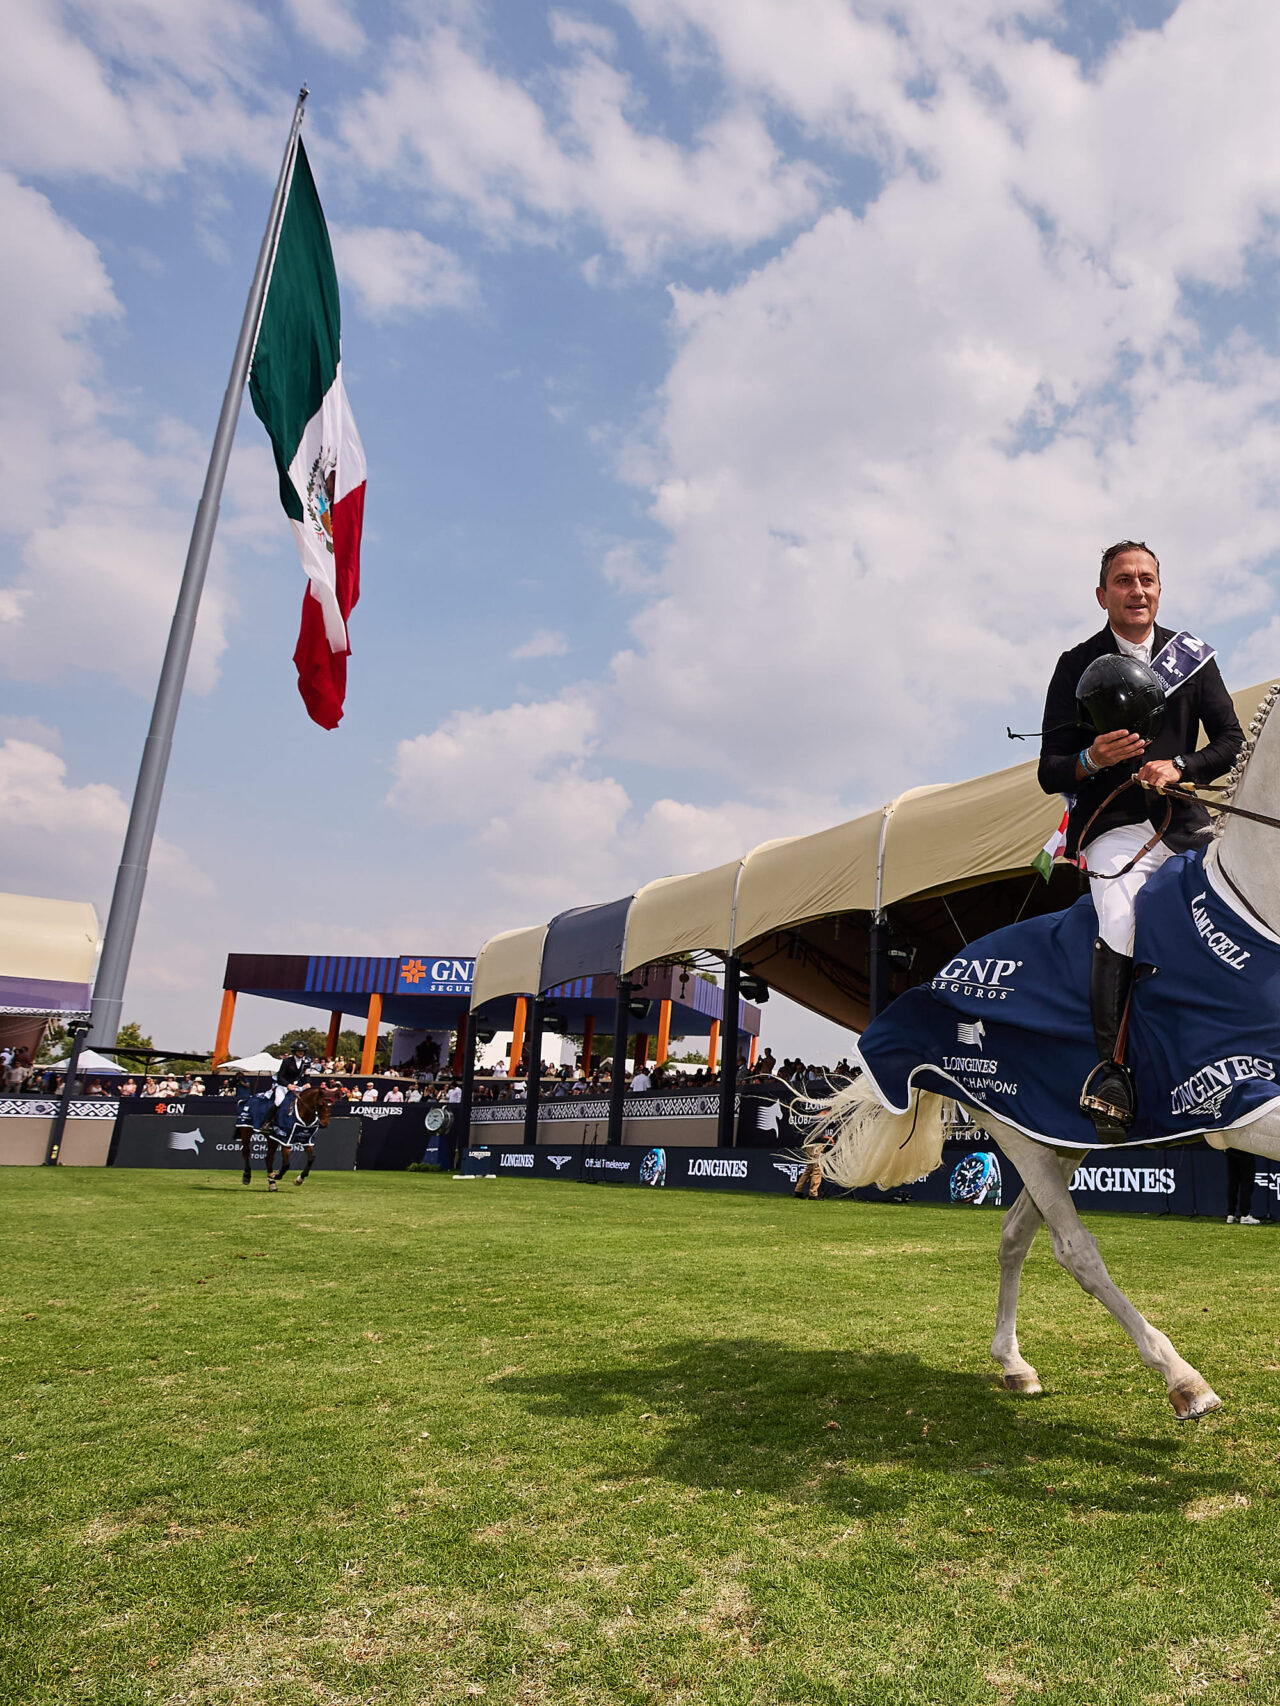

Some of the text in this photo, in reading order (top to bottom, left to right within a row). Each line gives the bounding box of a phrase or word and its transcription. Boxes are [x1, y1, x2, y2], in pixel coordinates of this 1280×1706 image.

[1191, 891, 1251, 970] LAMI-CELL
[931, 981, 1008, 999] SEGUROS
[942, 1056, 998, 1074] LONGINES
[350, 1106, 403, 1115] LONGINES
[500, 1154, 535, 1168] LONGINES
[687, 1159, 748, 1178] LONGINES
